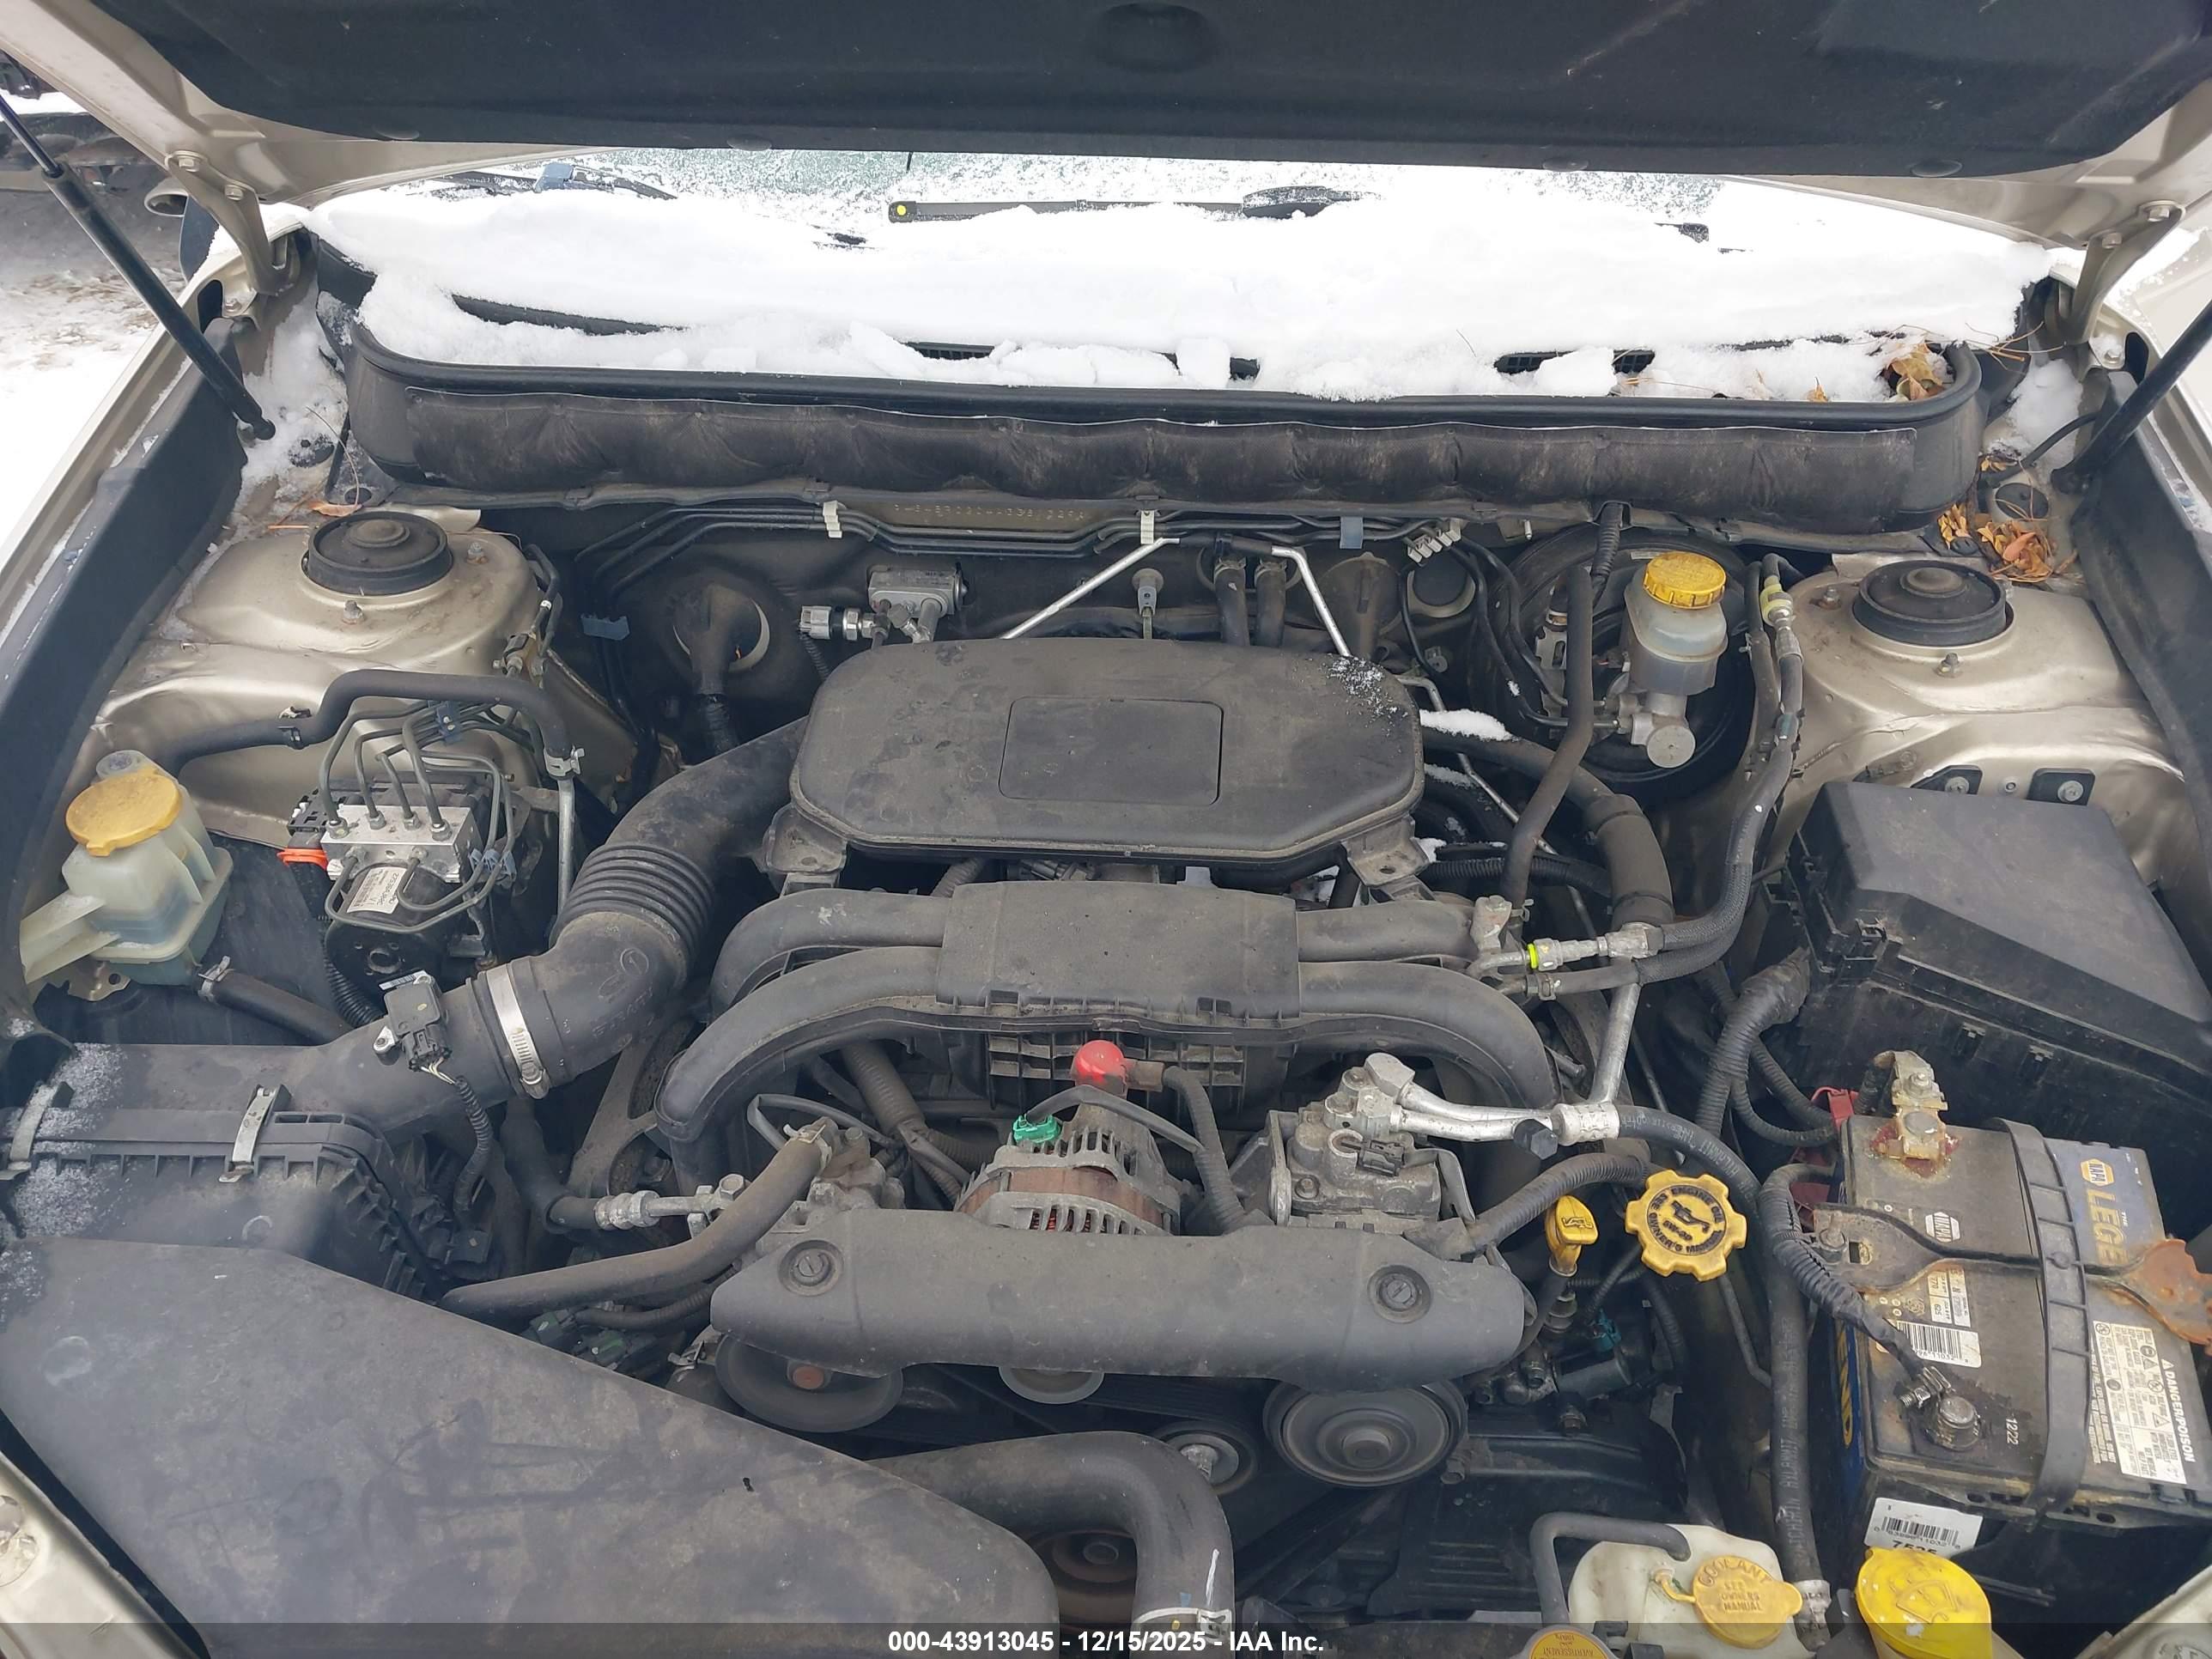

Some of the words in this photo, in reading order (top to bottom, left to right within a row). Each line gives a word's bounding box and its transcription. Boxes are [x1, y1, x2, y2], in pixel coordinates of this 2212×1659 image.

[1650, 1193, 1668, 1210] SEE
[1671, 1188, 1713, 1206] ENGINE
[1711, 1206, 1725, 1224] OIL
[2087, 1188, 2130, 1265] LEGE
[1929, 1277, 1939, 1289] 770
[1934, 1304, 1942, 1316] 625
[2165, 1370, 2197, 1463] DANGER/POISON
[2005, 1418, 2019, 1445] 12/22
[1698, 1559, 1773, 1587] COOLANT
[1723, 1601, 1763, 1612] MANUAL
[1543, 1647, 1594, 1657] AVERTISSEMENT
